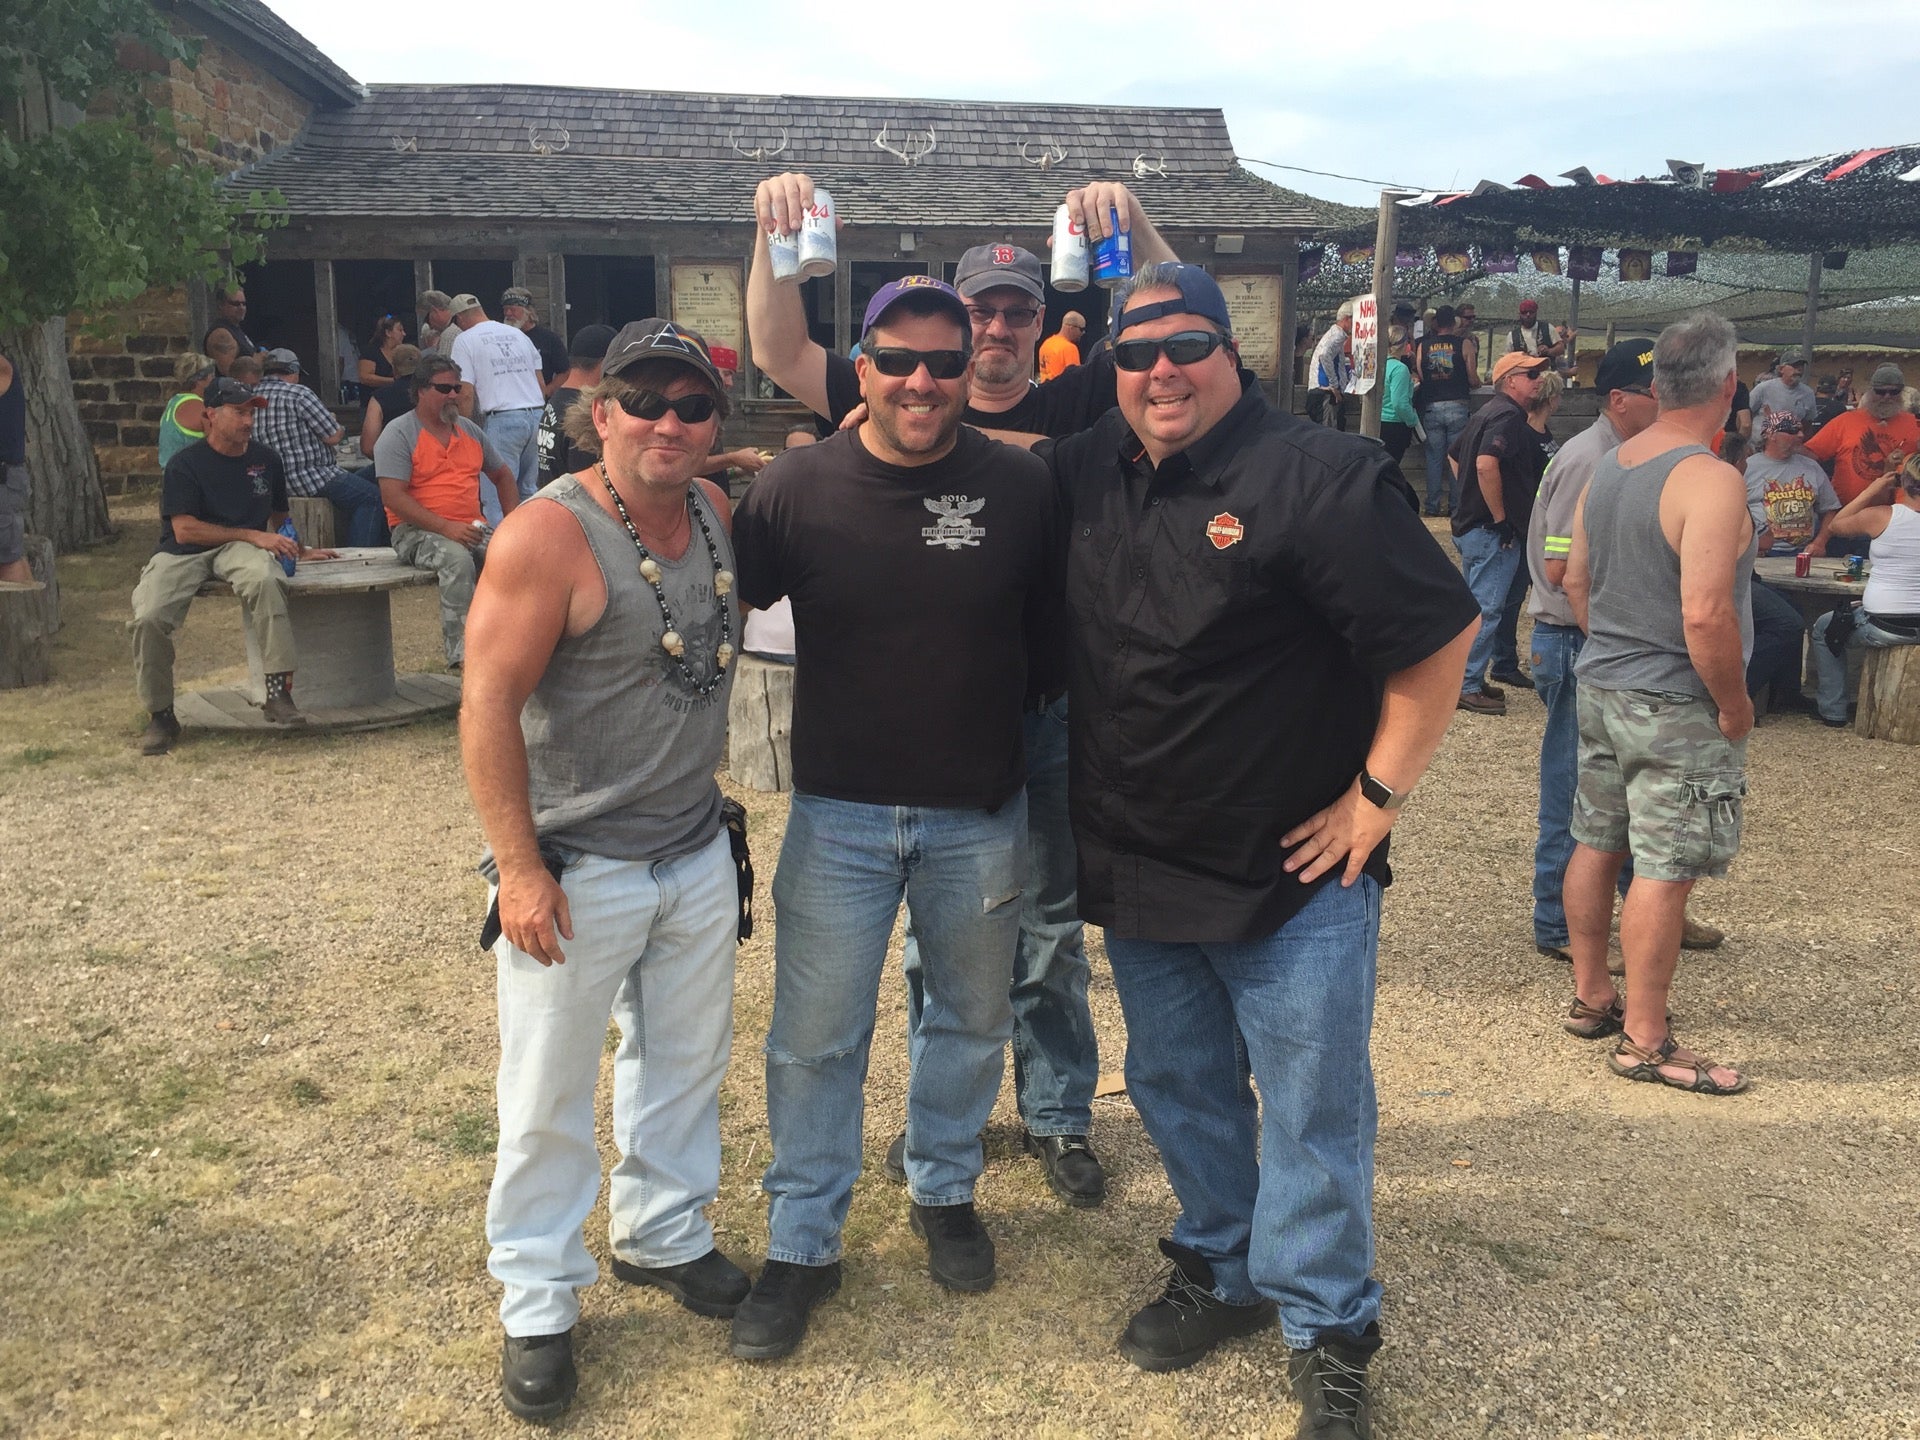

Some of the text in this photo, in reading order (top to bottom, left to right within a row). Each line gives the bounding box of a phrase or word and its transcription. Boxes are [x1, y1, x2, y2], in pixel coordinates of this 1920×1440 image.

[991, 246, 1016, 265] B
[940, 494, 968, 503] 2010
[1767, 488, 1813, 501] Sturgis
